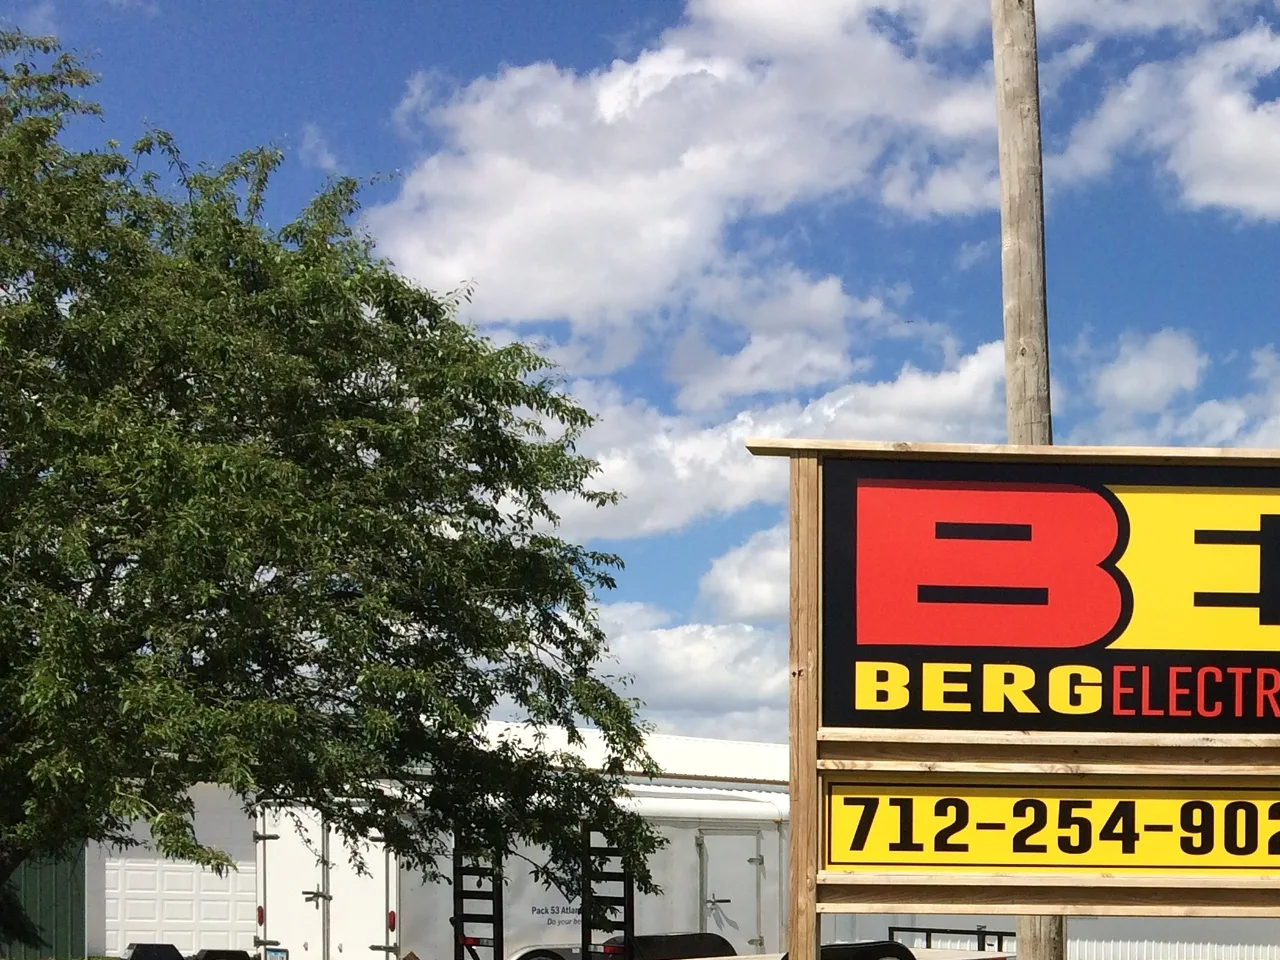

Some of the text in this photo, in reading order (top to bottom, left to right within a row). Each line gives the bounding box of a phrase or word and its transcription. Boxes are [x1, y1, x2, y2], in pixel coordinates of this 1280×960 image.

[855, 661, 1103, 715] BERG
[531, 906, 549, 914] Pack
[550, 906, 560, 914] 53
